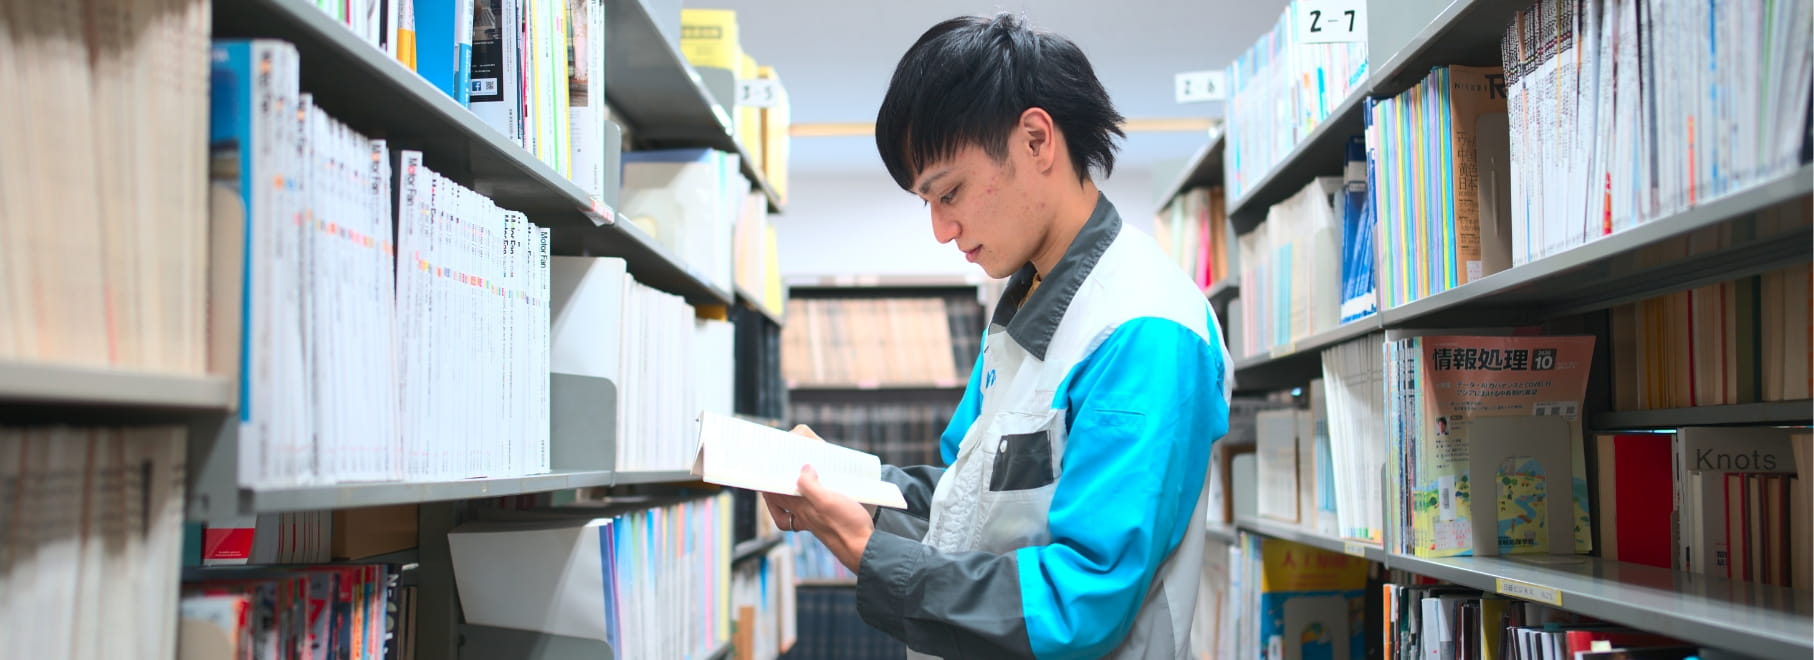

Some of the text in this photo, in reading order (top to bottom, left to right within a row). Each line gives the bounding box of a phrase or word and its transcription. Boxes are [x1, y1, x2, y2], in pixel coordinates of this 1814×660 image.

[370, 144, 382, 195] Motor Fan
[406, 157, 418, 207] Motor Fan
[539, 231, 549, 269] Motor Fan
[1432, 347, 1529, 371] 情報処理
[1535, 355, 1554, 370] 10
[1696, 447, 1778, 471] Knots
